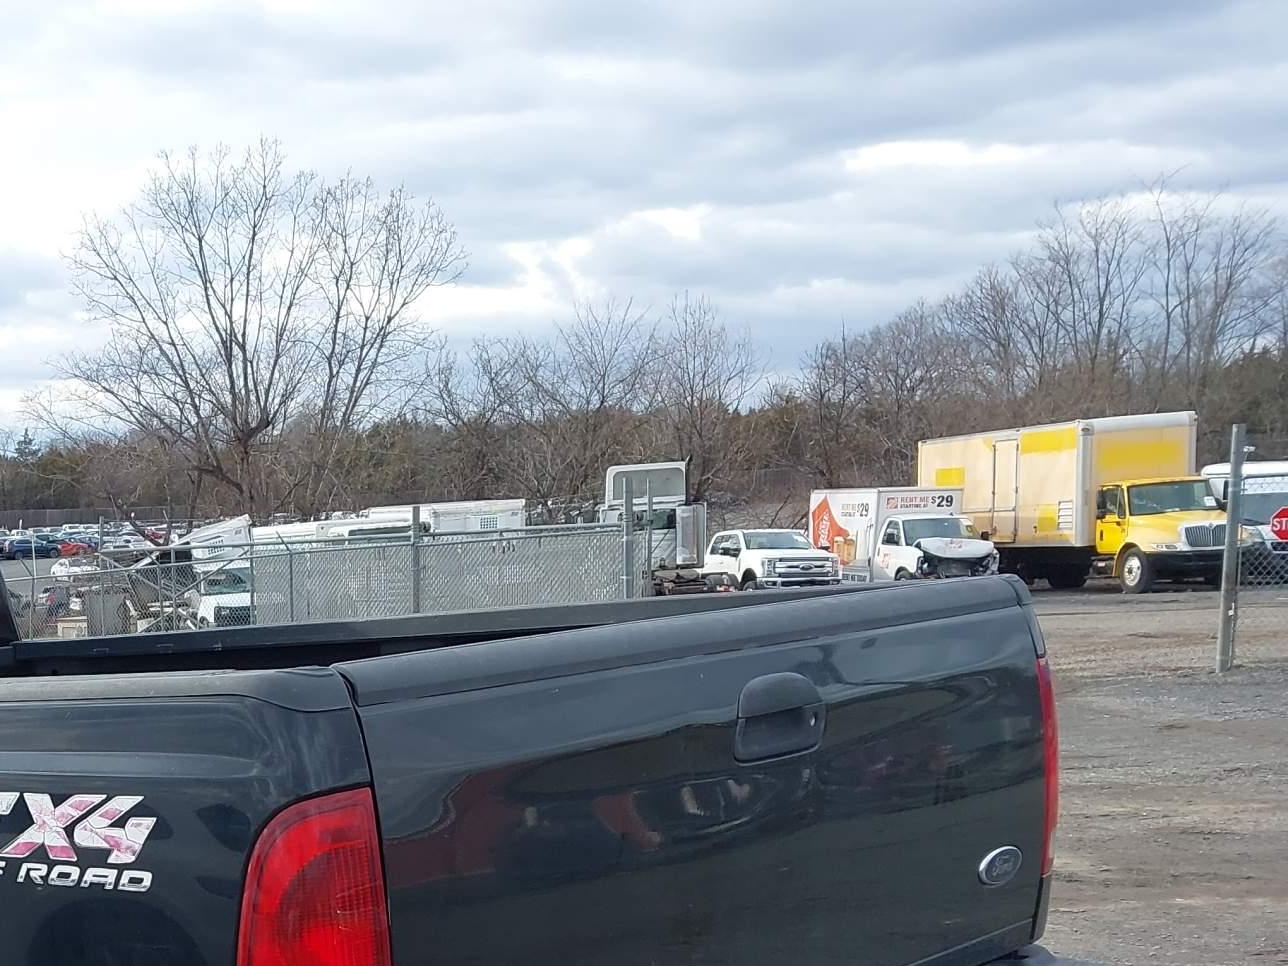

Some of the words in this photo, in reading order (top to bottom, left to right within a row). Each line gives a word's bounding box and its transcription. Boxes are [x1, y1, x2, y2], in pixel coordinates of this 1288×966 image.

[931, 494, 954, 508] $29
[856, 502, 870, 517] $29
[16, 862, 153, 892] ROAD
